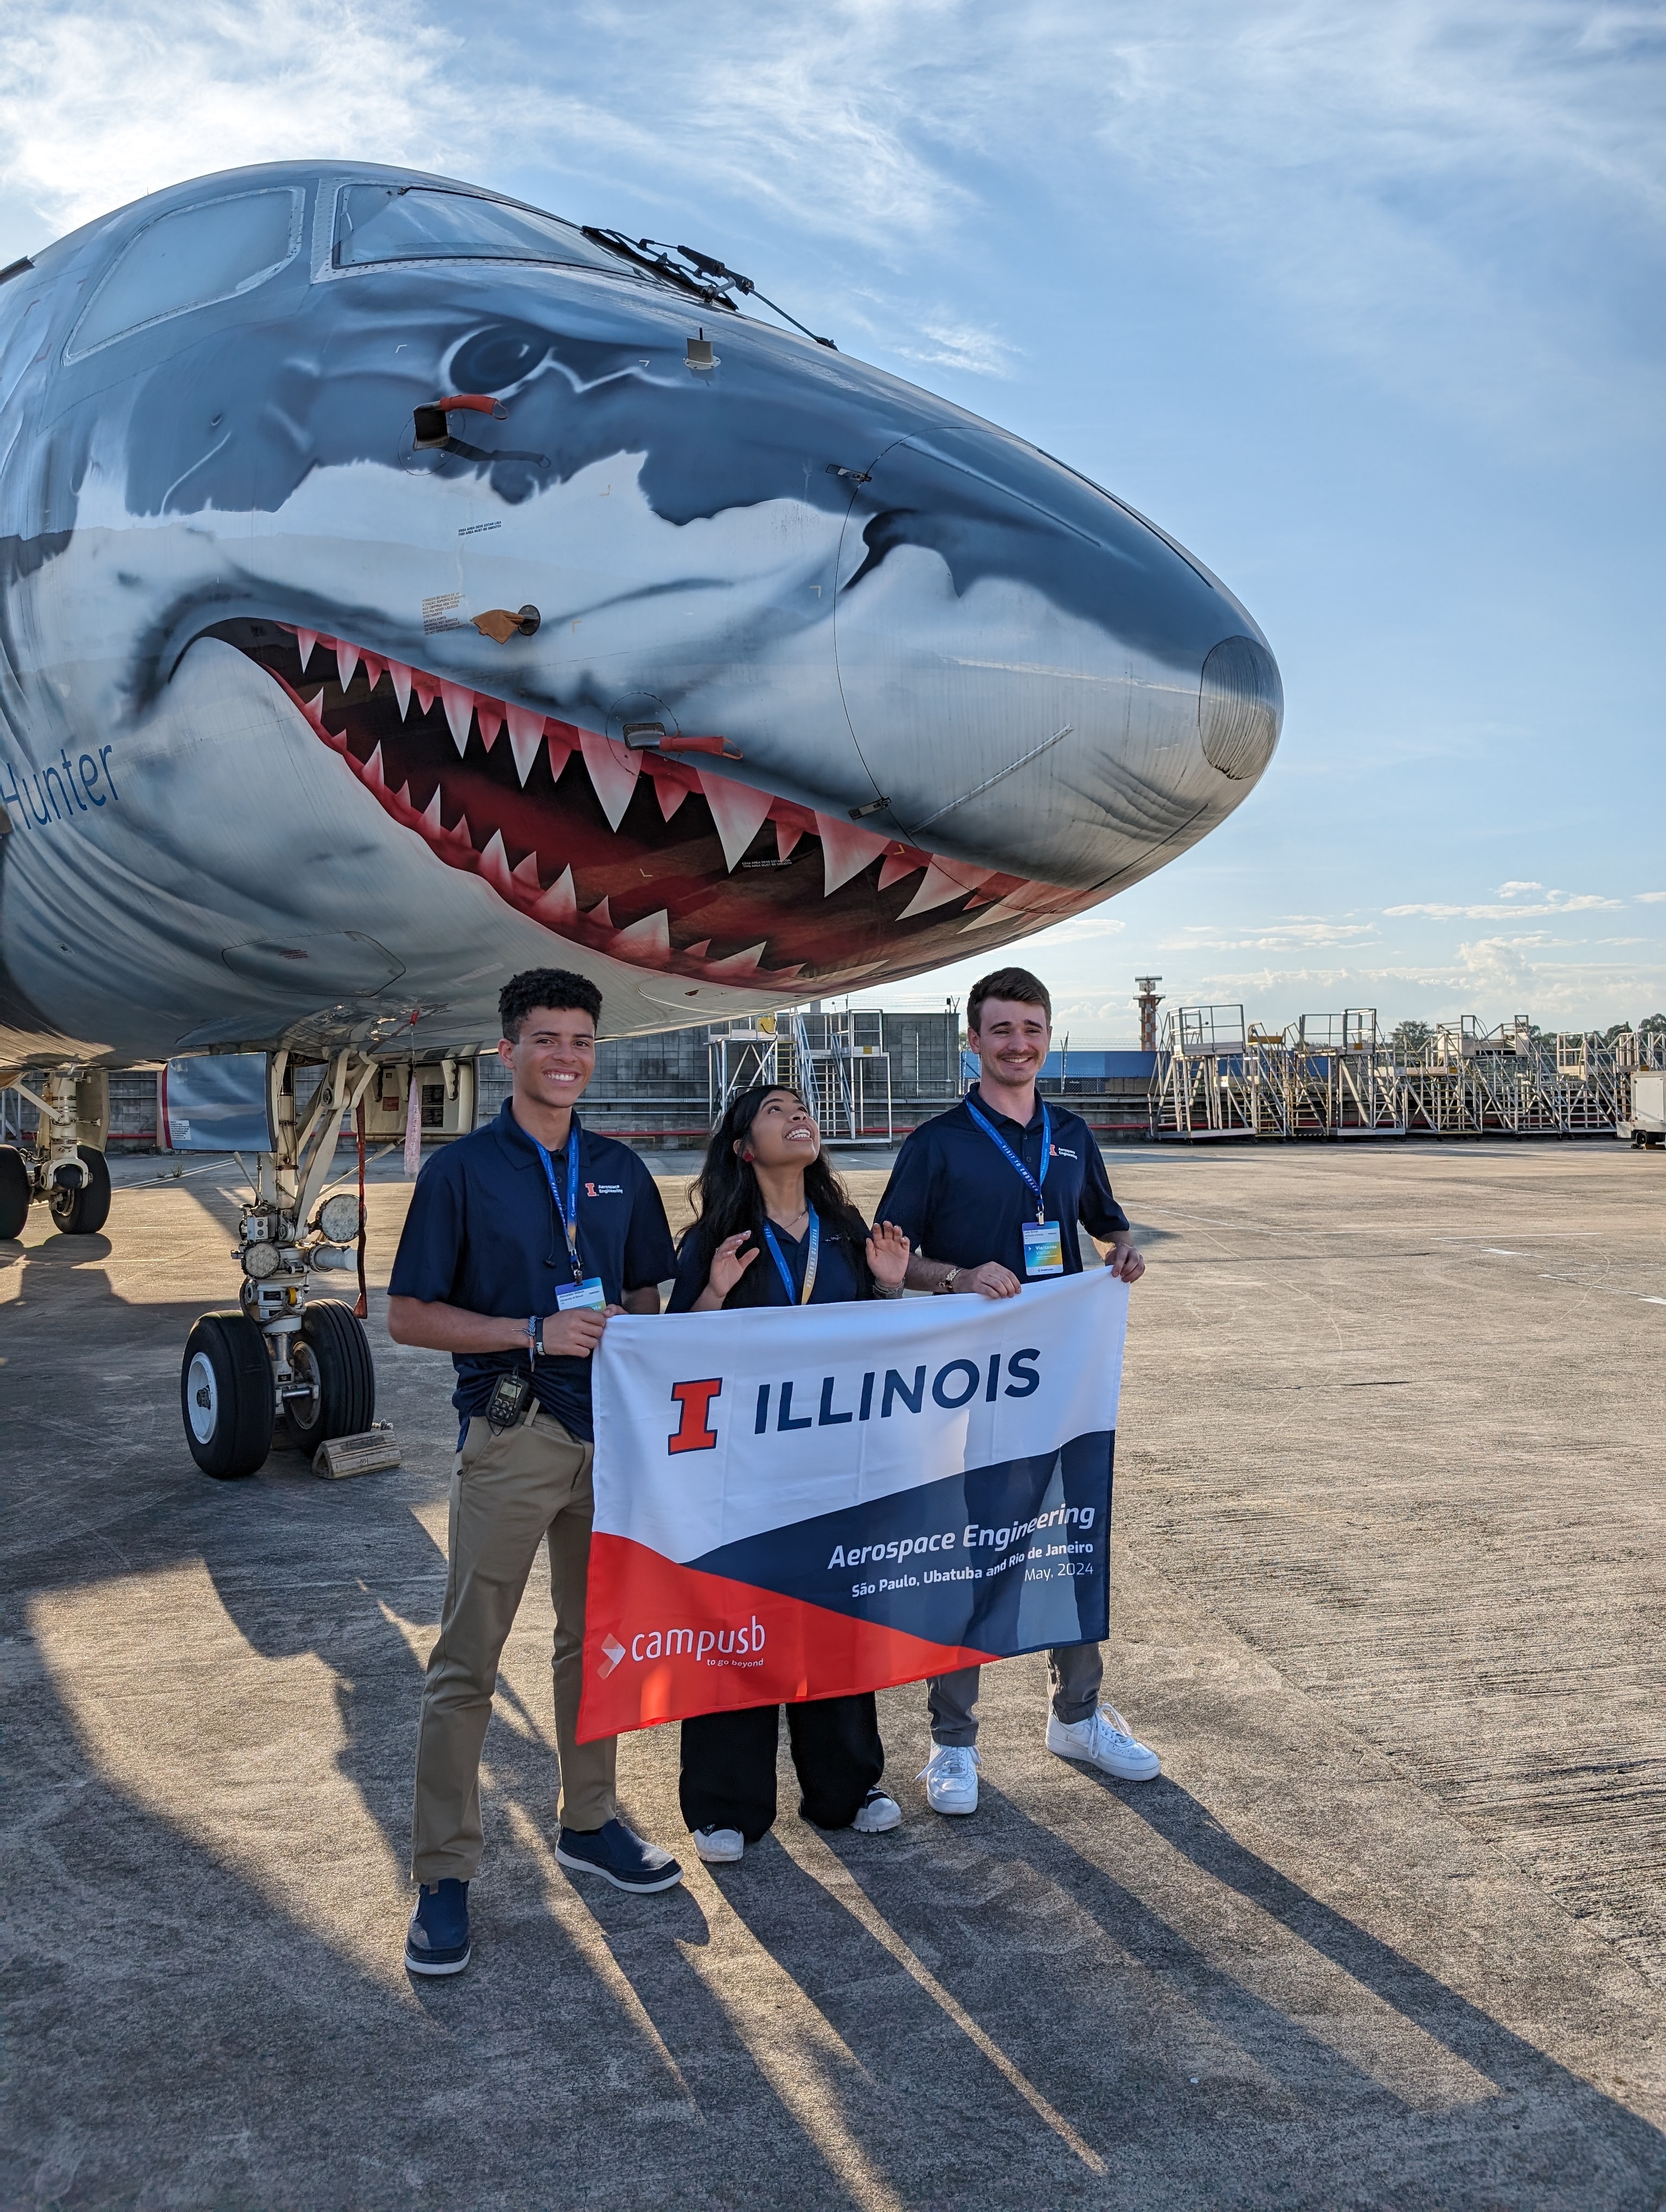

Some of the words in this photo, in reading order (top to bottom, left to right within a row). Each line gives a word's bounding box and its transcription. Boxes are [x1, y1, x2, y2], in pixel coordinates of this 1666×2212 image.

[0, 744, 119, 830] Hunter
[1002, 1145, 1015, 1159] VISIT
[1020, 1168, 1039, 1192] EMBRAER
[806, 1257, 816, 1288] EMBRAER
[754, 1348, 1041, 1435] ILLINOIS
[827, 1531, 956, 1570] Aerospace
[963, 1503, 1095, 1552] Engineering
[851, 1581, 876, 1598] São
[879, 1574, 920, 1592] Paulo,
[924, 1566, 983, 1584] Ubatuba
[986, 1559, 1007, 1577] and
[1009, 1552, 1025, 1568] Rio
[1028, 1546, 1042, 1560] de
[1045, 1541, 1094, 1557] Janeiro
[1024, 1567, 1054, 1582] May,
[1058, 1562, 1094, 1577] 2024
[632, 1615, 765, 1661] campusb
[732, 1658, 764, 1669] beyond
